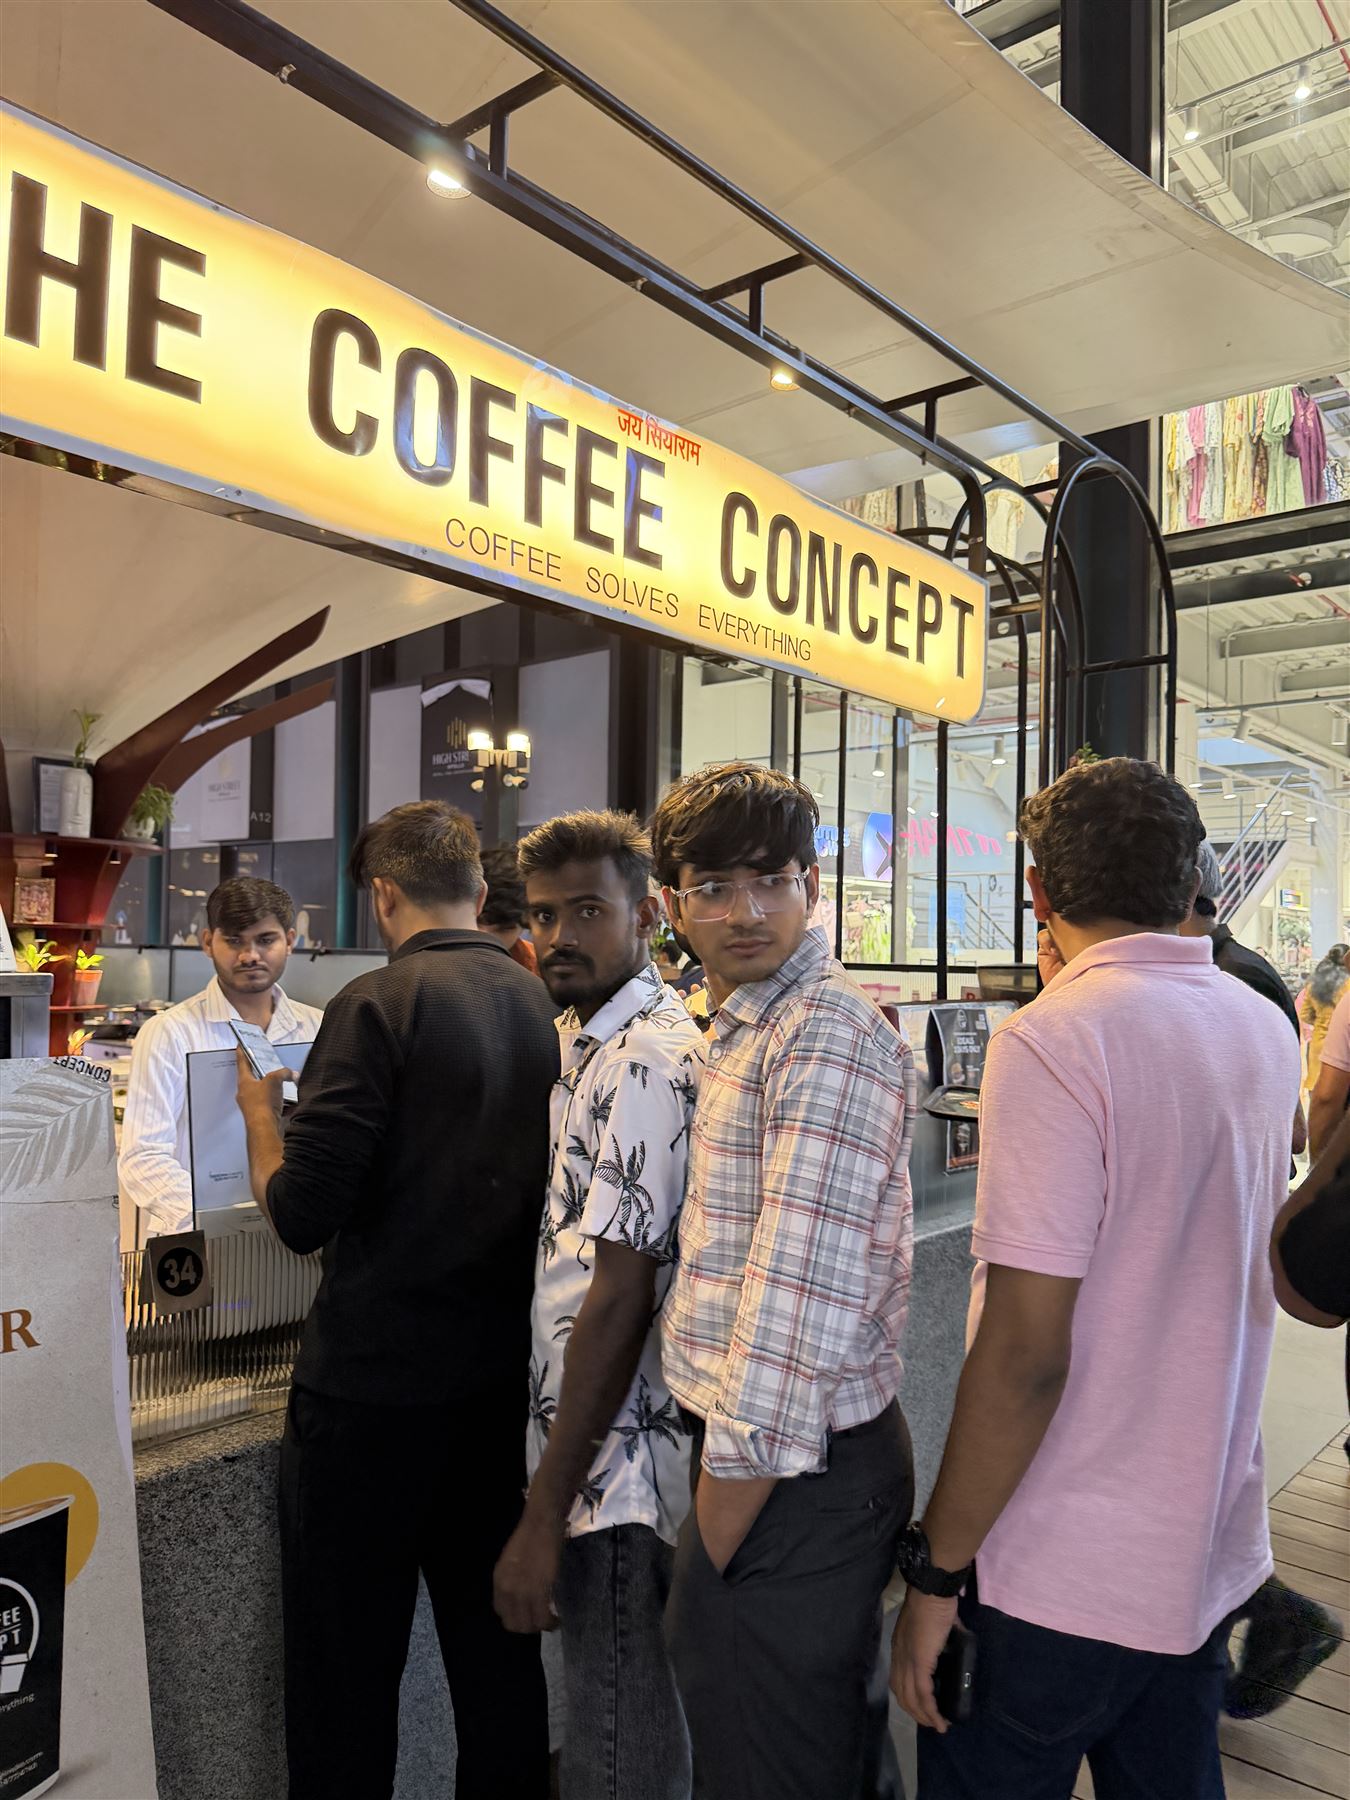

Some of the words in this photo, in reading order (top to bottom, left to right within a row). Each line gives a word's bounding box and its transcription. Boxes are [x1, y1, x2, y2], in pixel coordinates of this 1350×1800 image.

[618, 408, 643, 441] जय
[646, 414, 701, 466] सियाराम
[307, 308, 665, 571] COFFEE
[720, 491, 974, 679] CONCEPT
[445, 518, 562, 582] COFFEE
[586, 566, 679, 618] SOLVES
[699, 604, 811, 661] EVERYTHING
[250, 811, 272, 823] A12
[164, 1255, 197, 1289] 34
[0, 1309, 41, 1354] R
